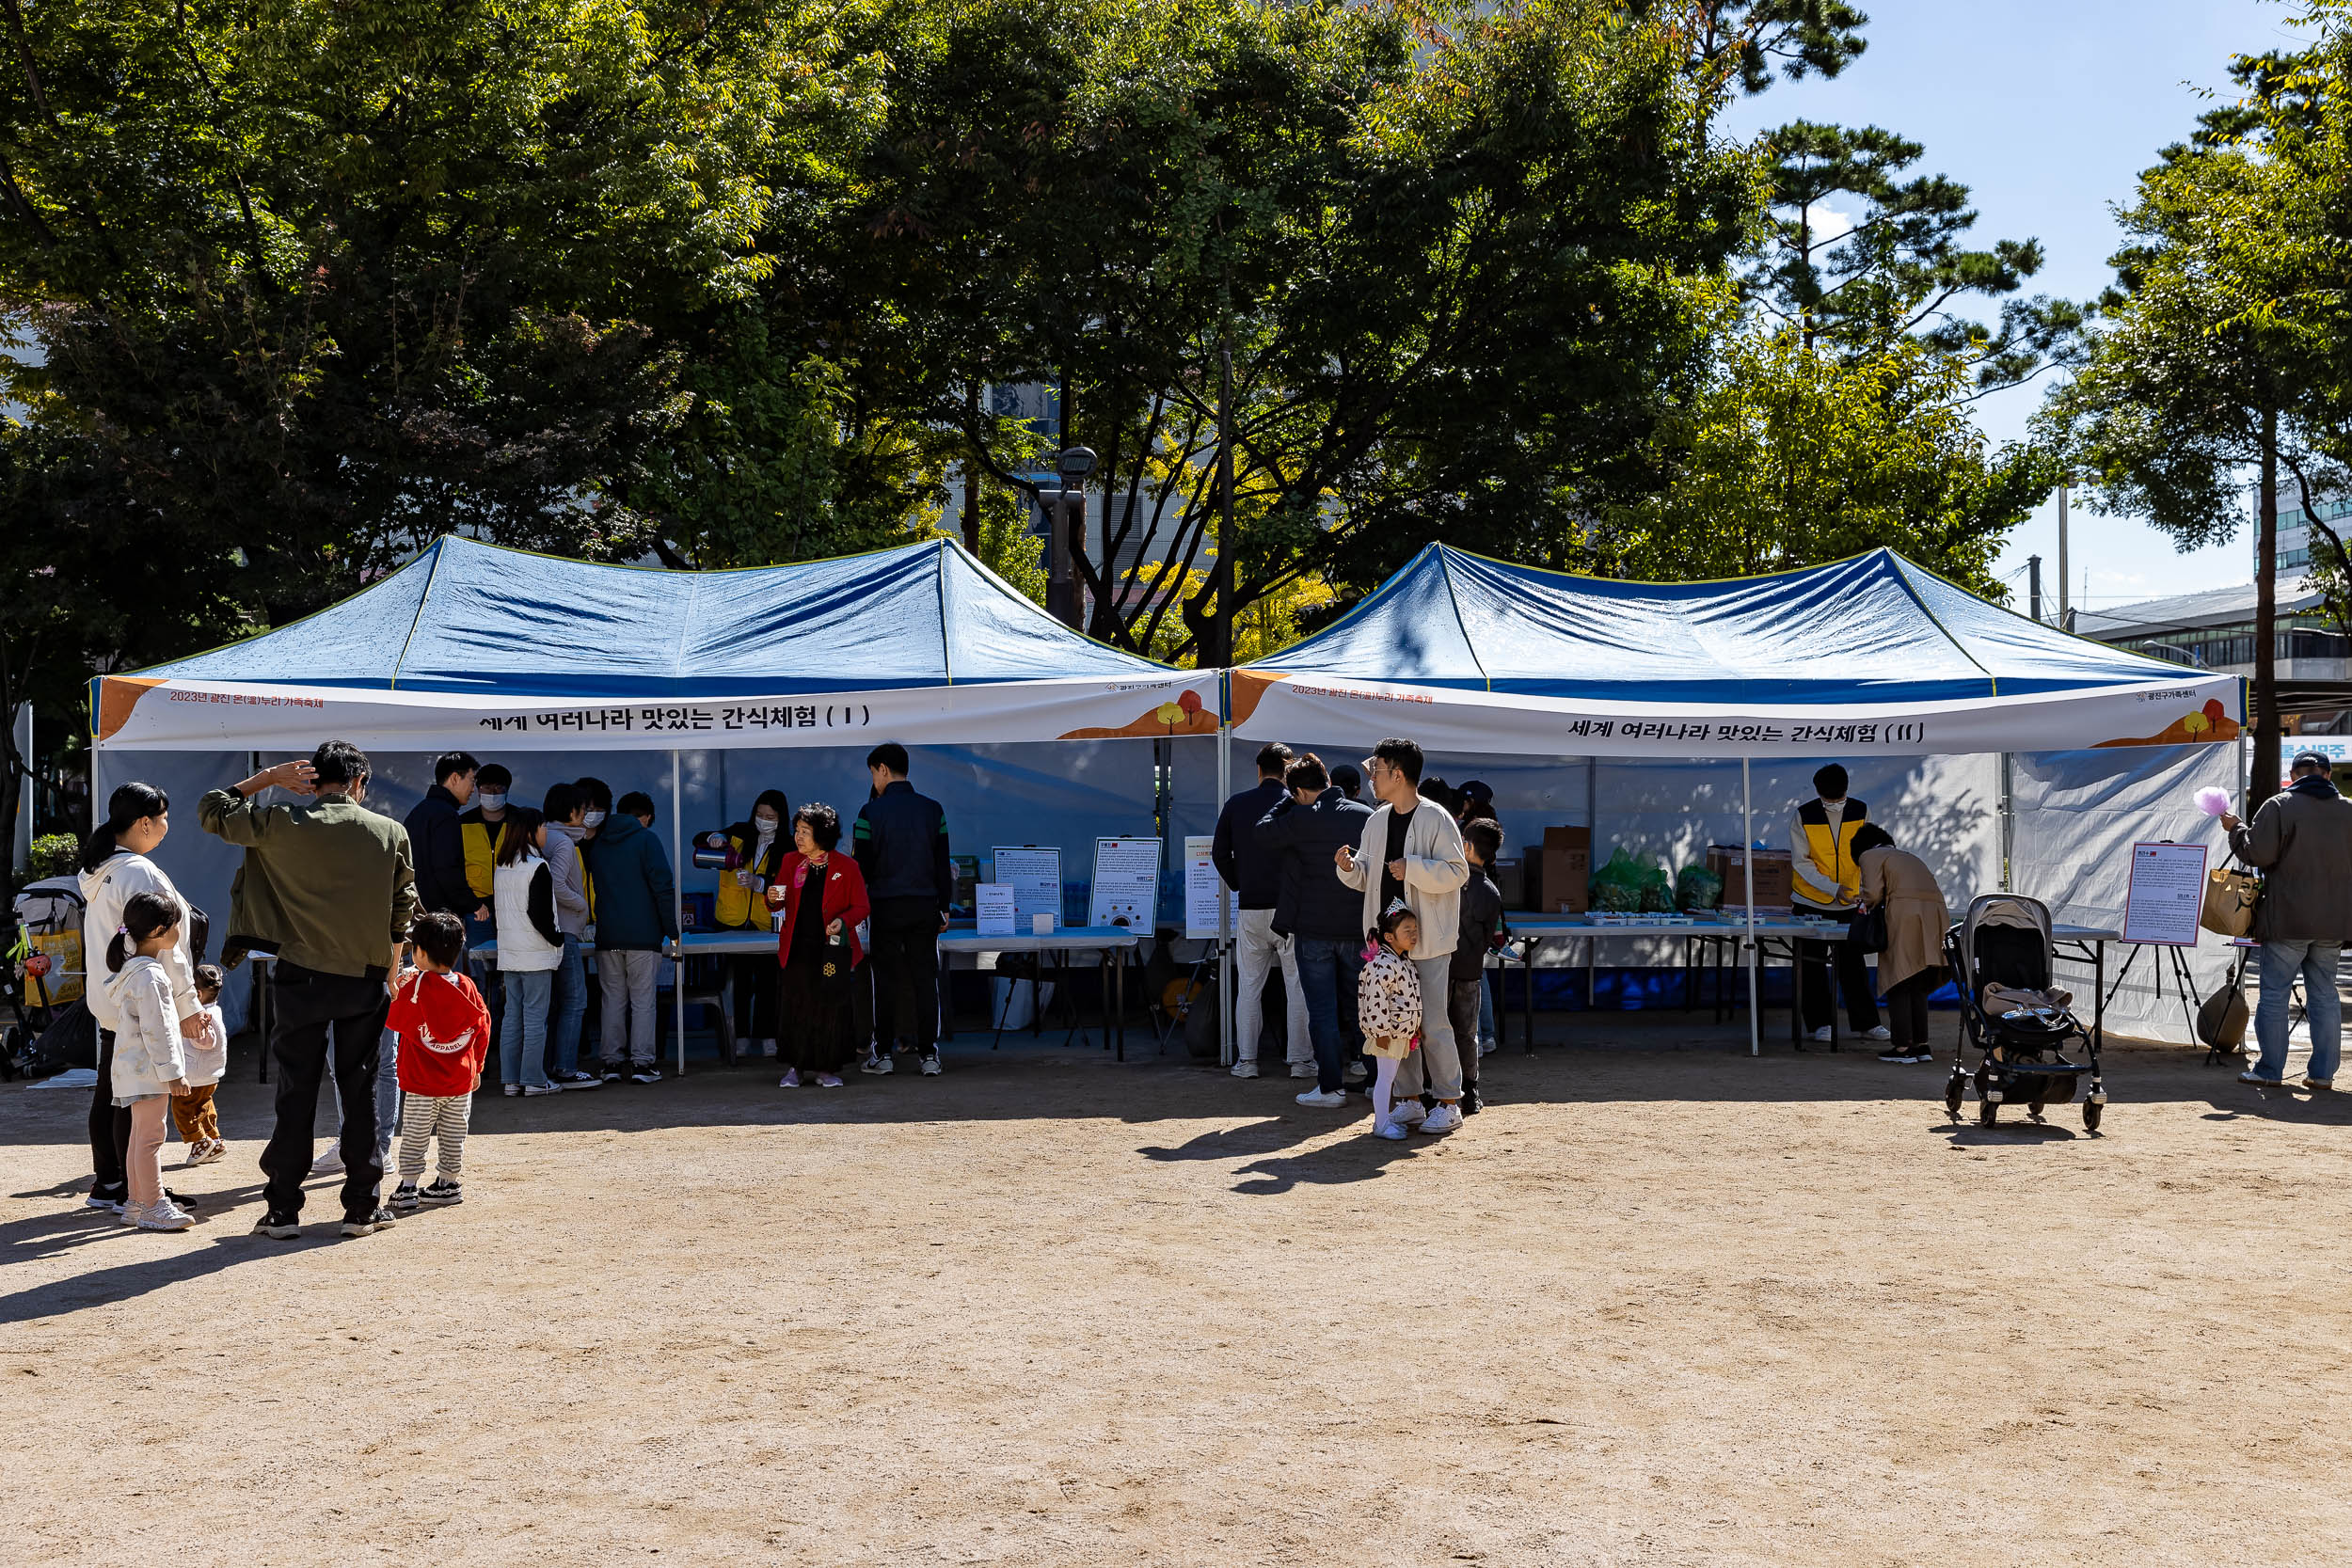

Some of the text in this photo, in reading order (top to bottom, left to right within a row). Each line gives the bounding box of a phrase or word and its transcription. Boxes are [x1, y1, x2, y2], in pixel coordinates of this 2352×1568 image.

[1292, 685, 1327, 696] 2023년
[170, 691, 208, 703] 2023년
[210, 693, 230, 705] 광진
[283, 697, 324, 708] 가족축제
[535, 708, 634, 731] 여러나라
[642, 707, 714, 731] 맛있는
[722, 705, 817, 730] 간식체험
[1567, 720, 1615, 738] 세계
[1620, 721, 1711, 740] 여러나라
[1716, 724, 1784, 741] 맛있는
[1790, 723, 1879, 743] 간식체험
[430, 1042, 462, 1052] APPAREL
